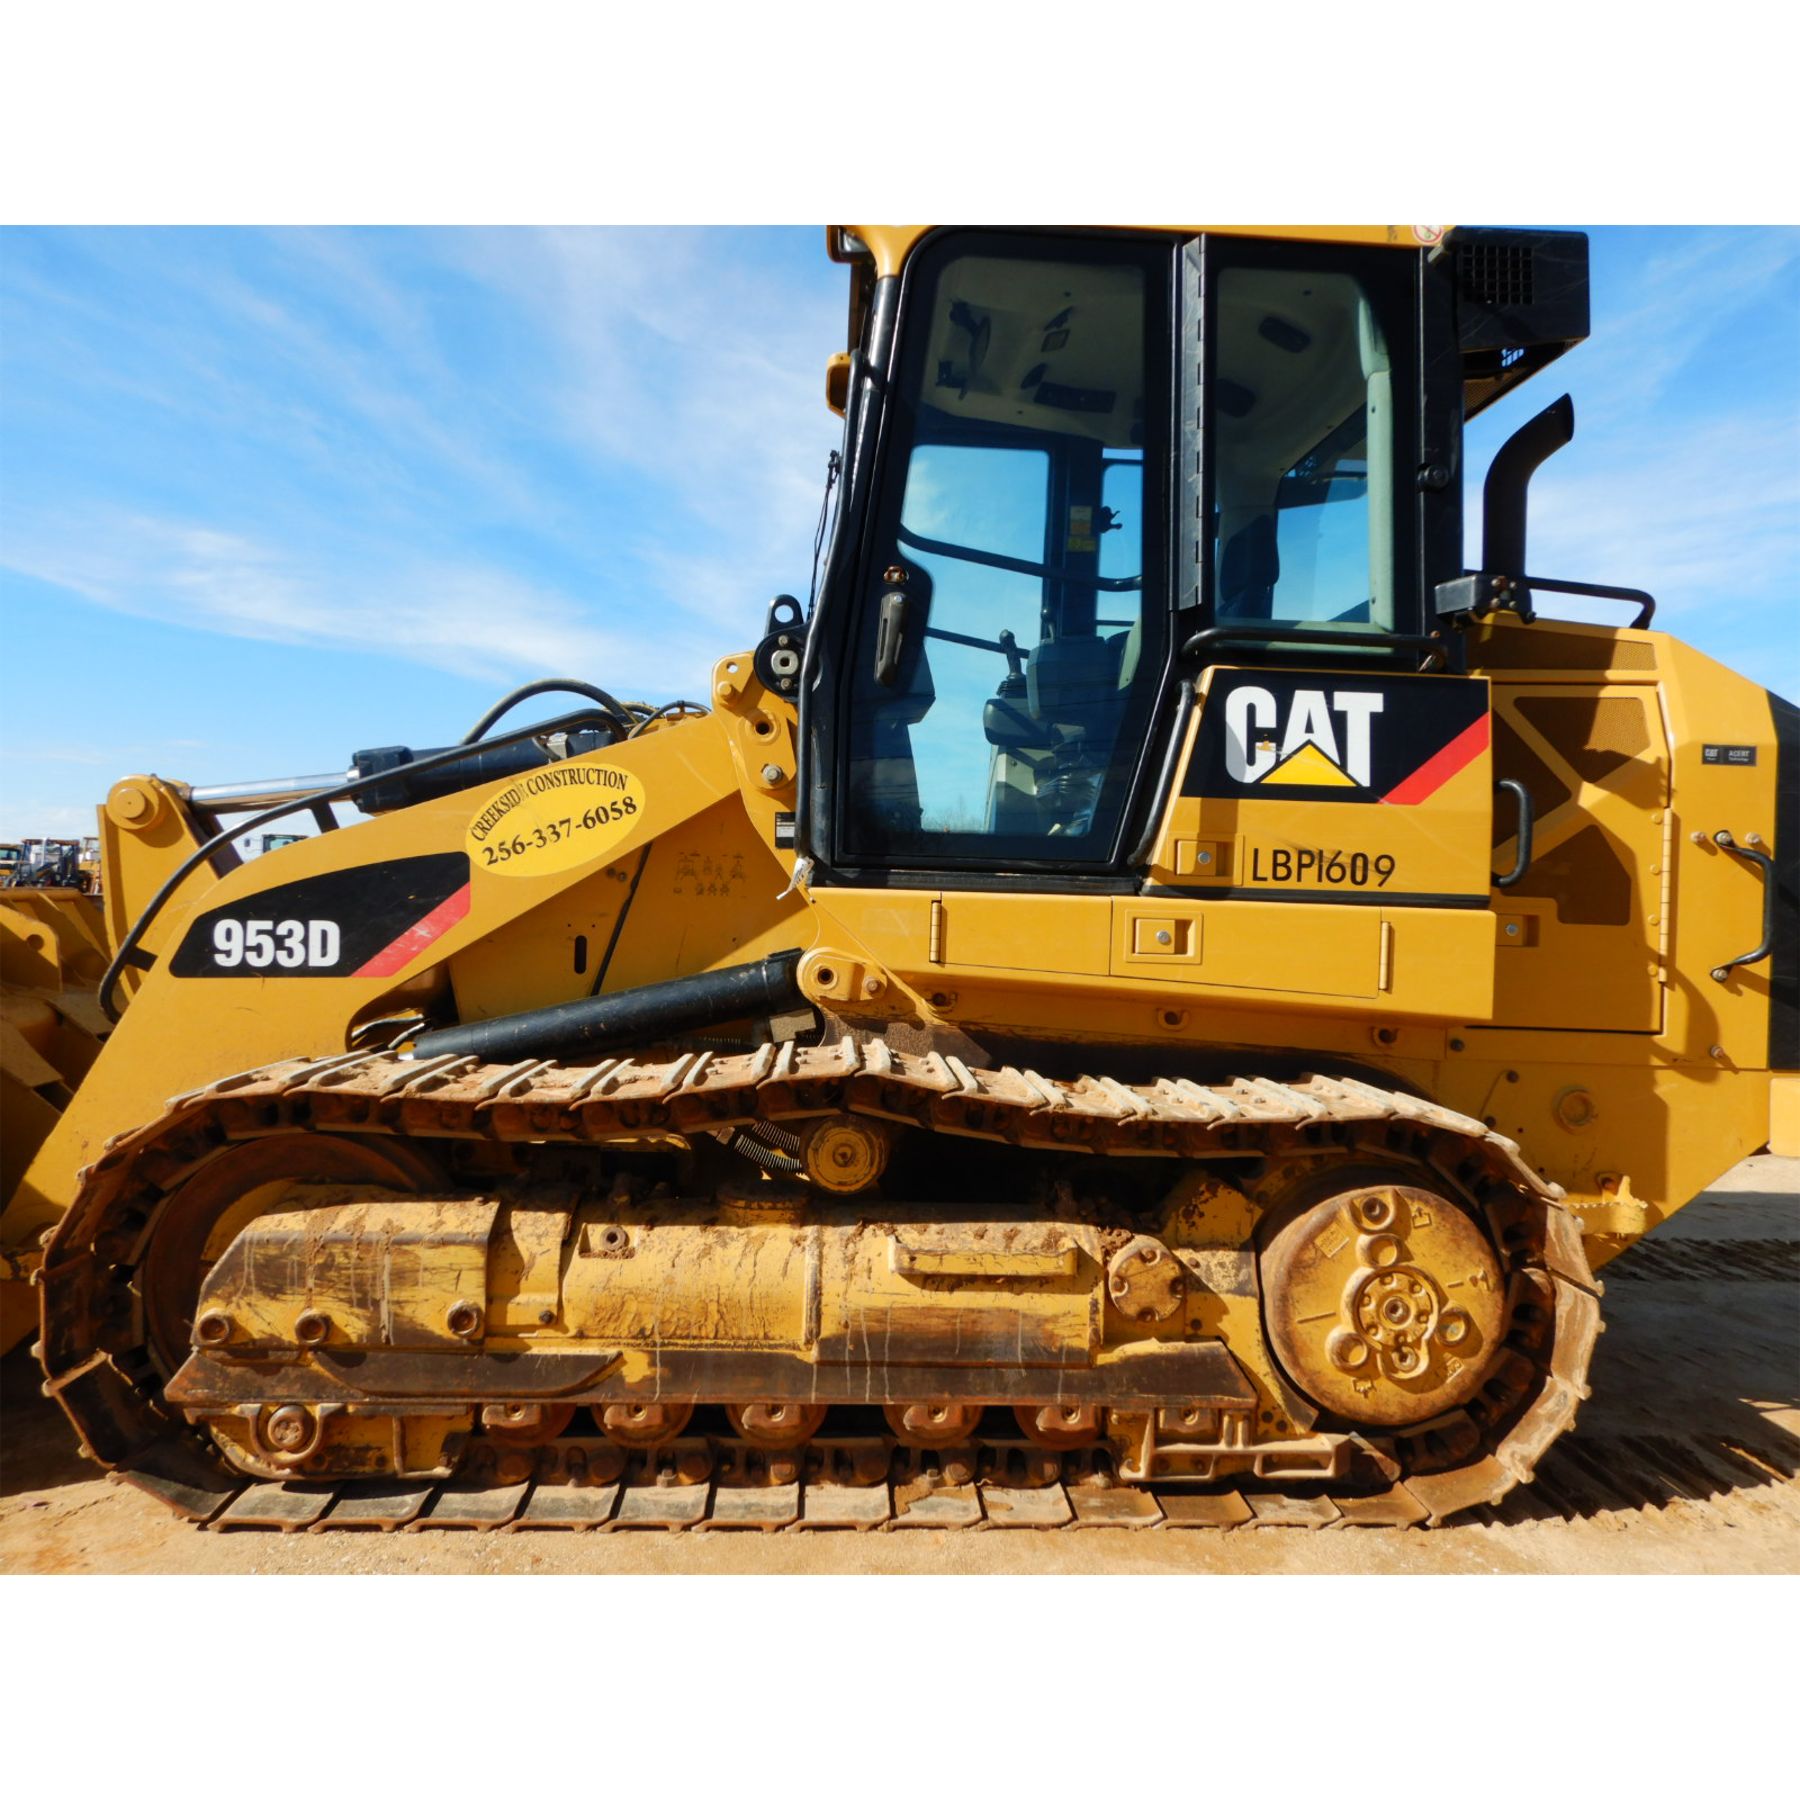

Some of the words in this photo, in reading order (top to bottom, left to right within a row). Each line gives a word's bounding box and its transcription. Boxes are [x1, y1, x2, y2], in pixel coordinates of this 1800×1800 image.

[1226, 686, 1384, 787] CAT
[526, 768, 628, 795] CONSTRUCTION
[482, 796, 637, 866] 256-337-6058
[213, 919, 340, 967] 953D
